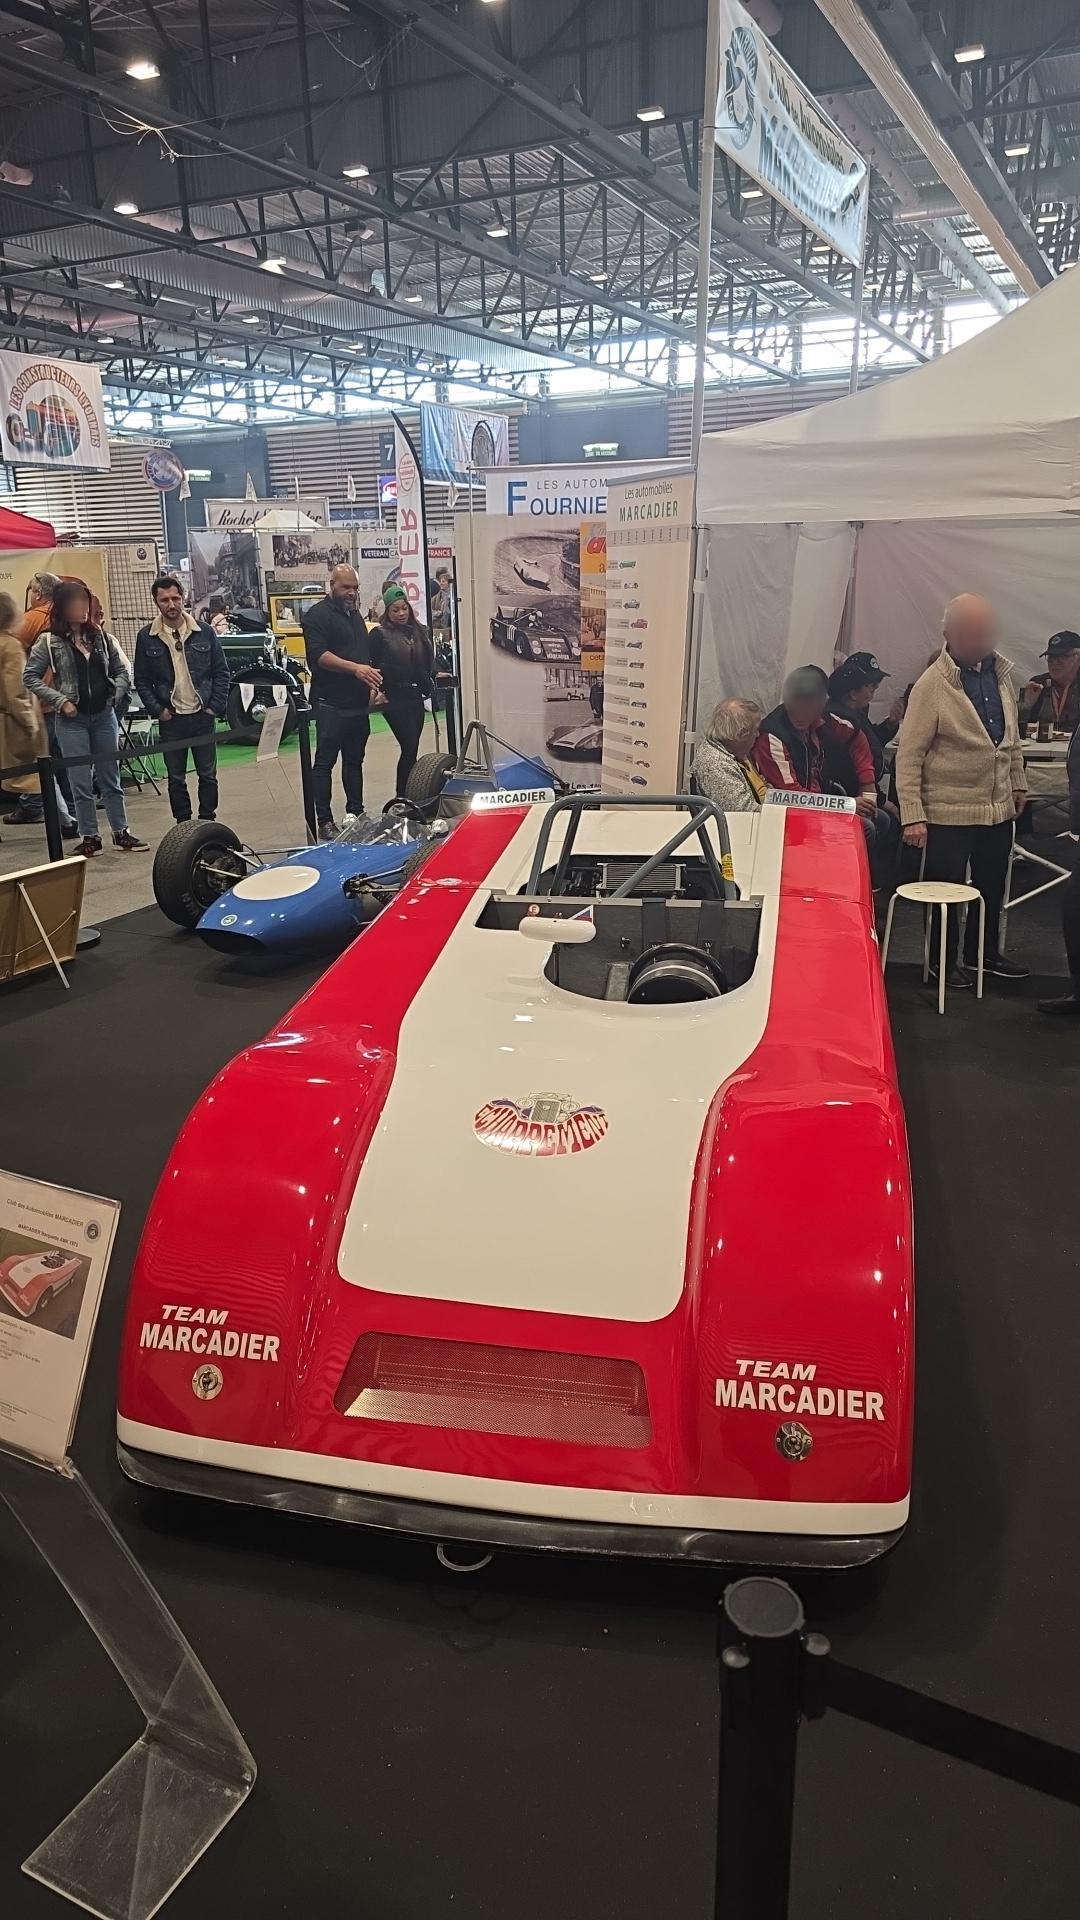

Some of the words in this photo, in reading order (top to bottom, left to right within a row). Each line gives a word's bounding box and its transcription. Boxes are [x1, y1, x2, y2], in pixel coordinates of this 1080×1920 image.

[9, 386, 24, 411] LES
[17, 364, 82, 397] CONSTRUCTEURS
[77, 390, 101, 448] LYONNAIS
[384, 444, 394, 461] 7
[536, 481, 558, 490] LES
[565, 478, 608, 488] AUTOM
[624, 489, 634, 500] Les
[635, 482, 673, 497] automobiles
[507, 480, 607, 516] FOURNIE
[619, 500, 678, 522] MARCADIER
[375, 538, 392, 546] CLUB
[363, 550, 388, 558] VETERAN
[480, 791, 546, 804] MARCADIER
[772, 792, 846, 809] MARCADIER
[55, 1214, 84, 1226] MARCADIER
[162, 1305, 229, 1325] TEAM
[140, 1323, 280, 1362] MARCADIER
[736, 1359, 817, 1381] TEAM
[715, 1378, 885, 1421] MARCADIER
